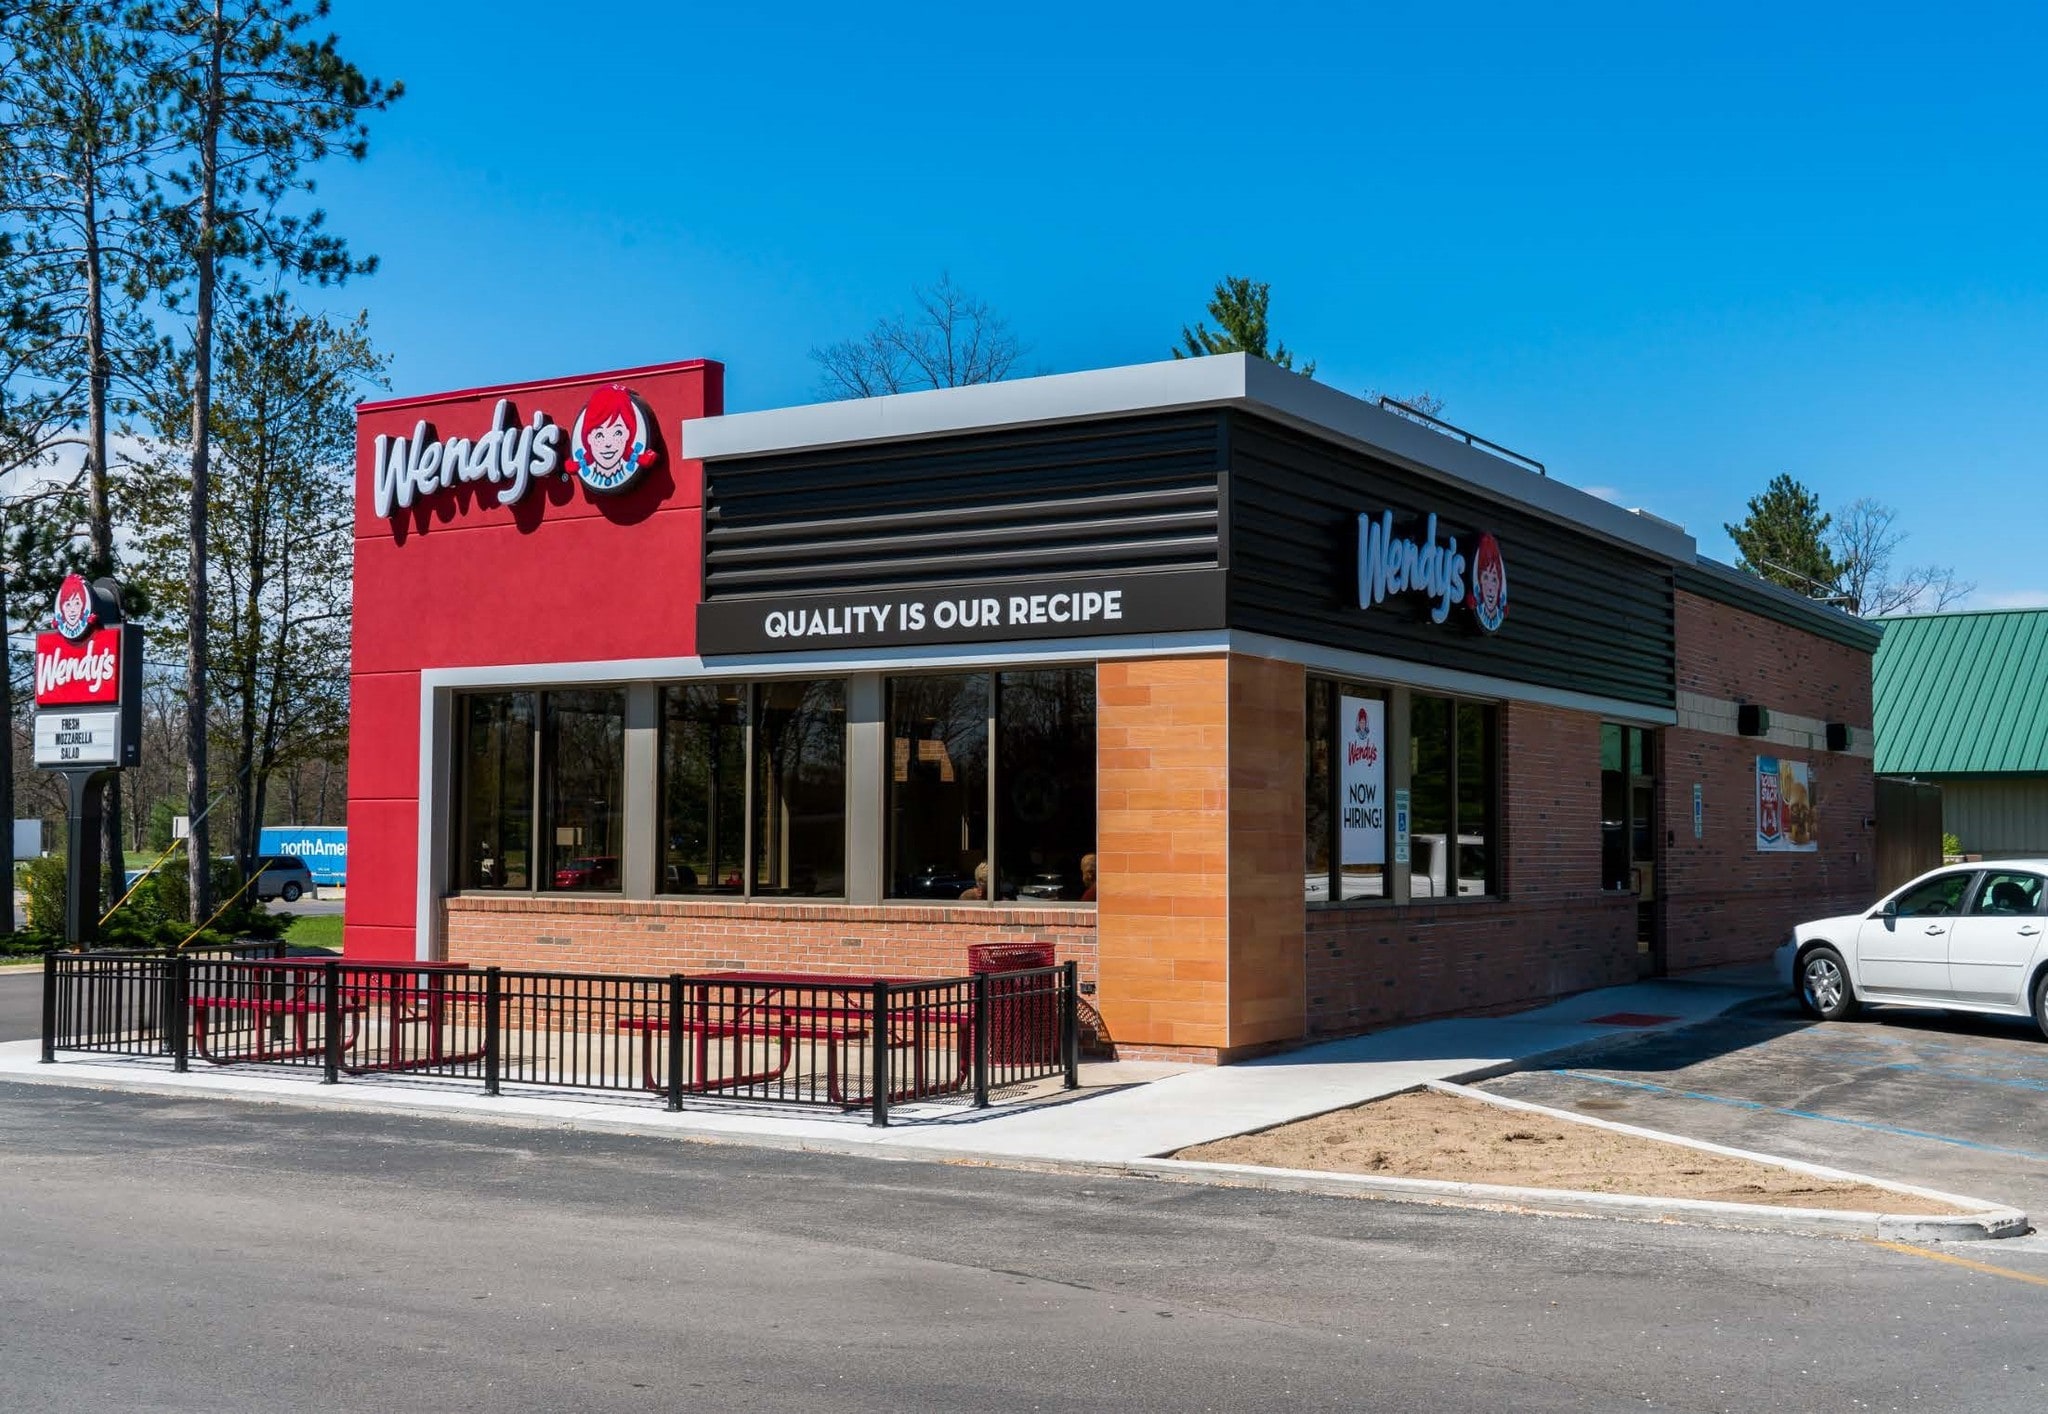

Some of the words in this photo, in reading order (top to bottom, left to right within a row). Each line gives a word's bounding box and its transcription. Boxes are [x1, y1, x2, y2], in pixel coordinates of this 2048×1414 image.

[374, 399, 559, 518] Wendy's
[1358, 509, 1465, 624] Wendy's
[765, 604, 892, 638] QUALITY
[899, 602, 926, 631] IS
[933, 598, 1000, 629] OUR
[1009, 590, 1122, 625] RECIPE
[37, 640, 115, 696] Wendy's
[61, 718, 80, 730] FRESH
[55, 732, 93, 745] MOZZARELLA
[60, 747, 80, 760] SALAD
[1350, 783, 1376, 805] NOW
[1344, 808, 1382, 829] HIRING!
